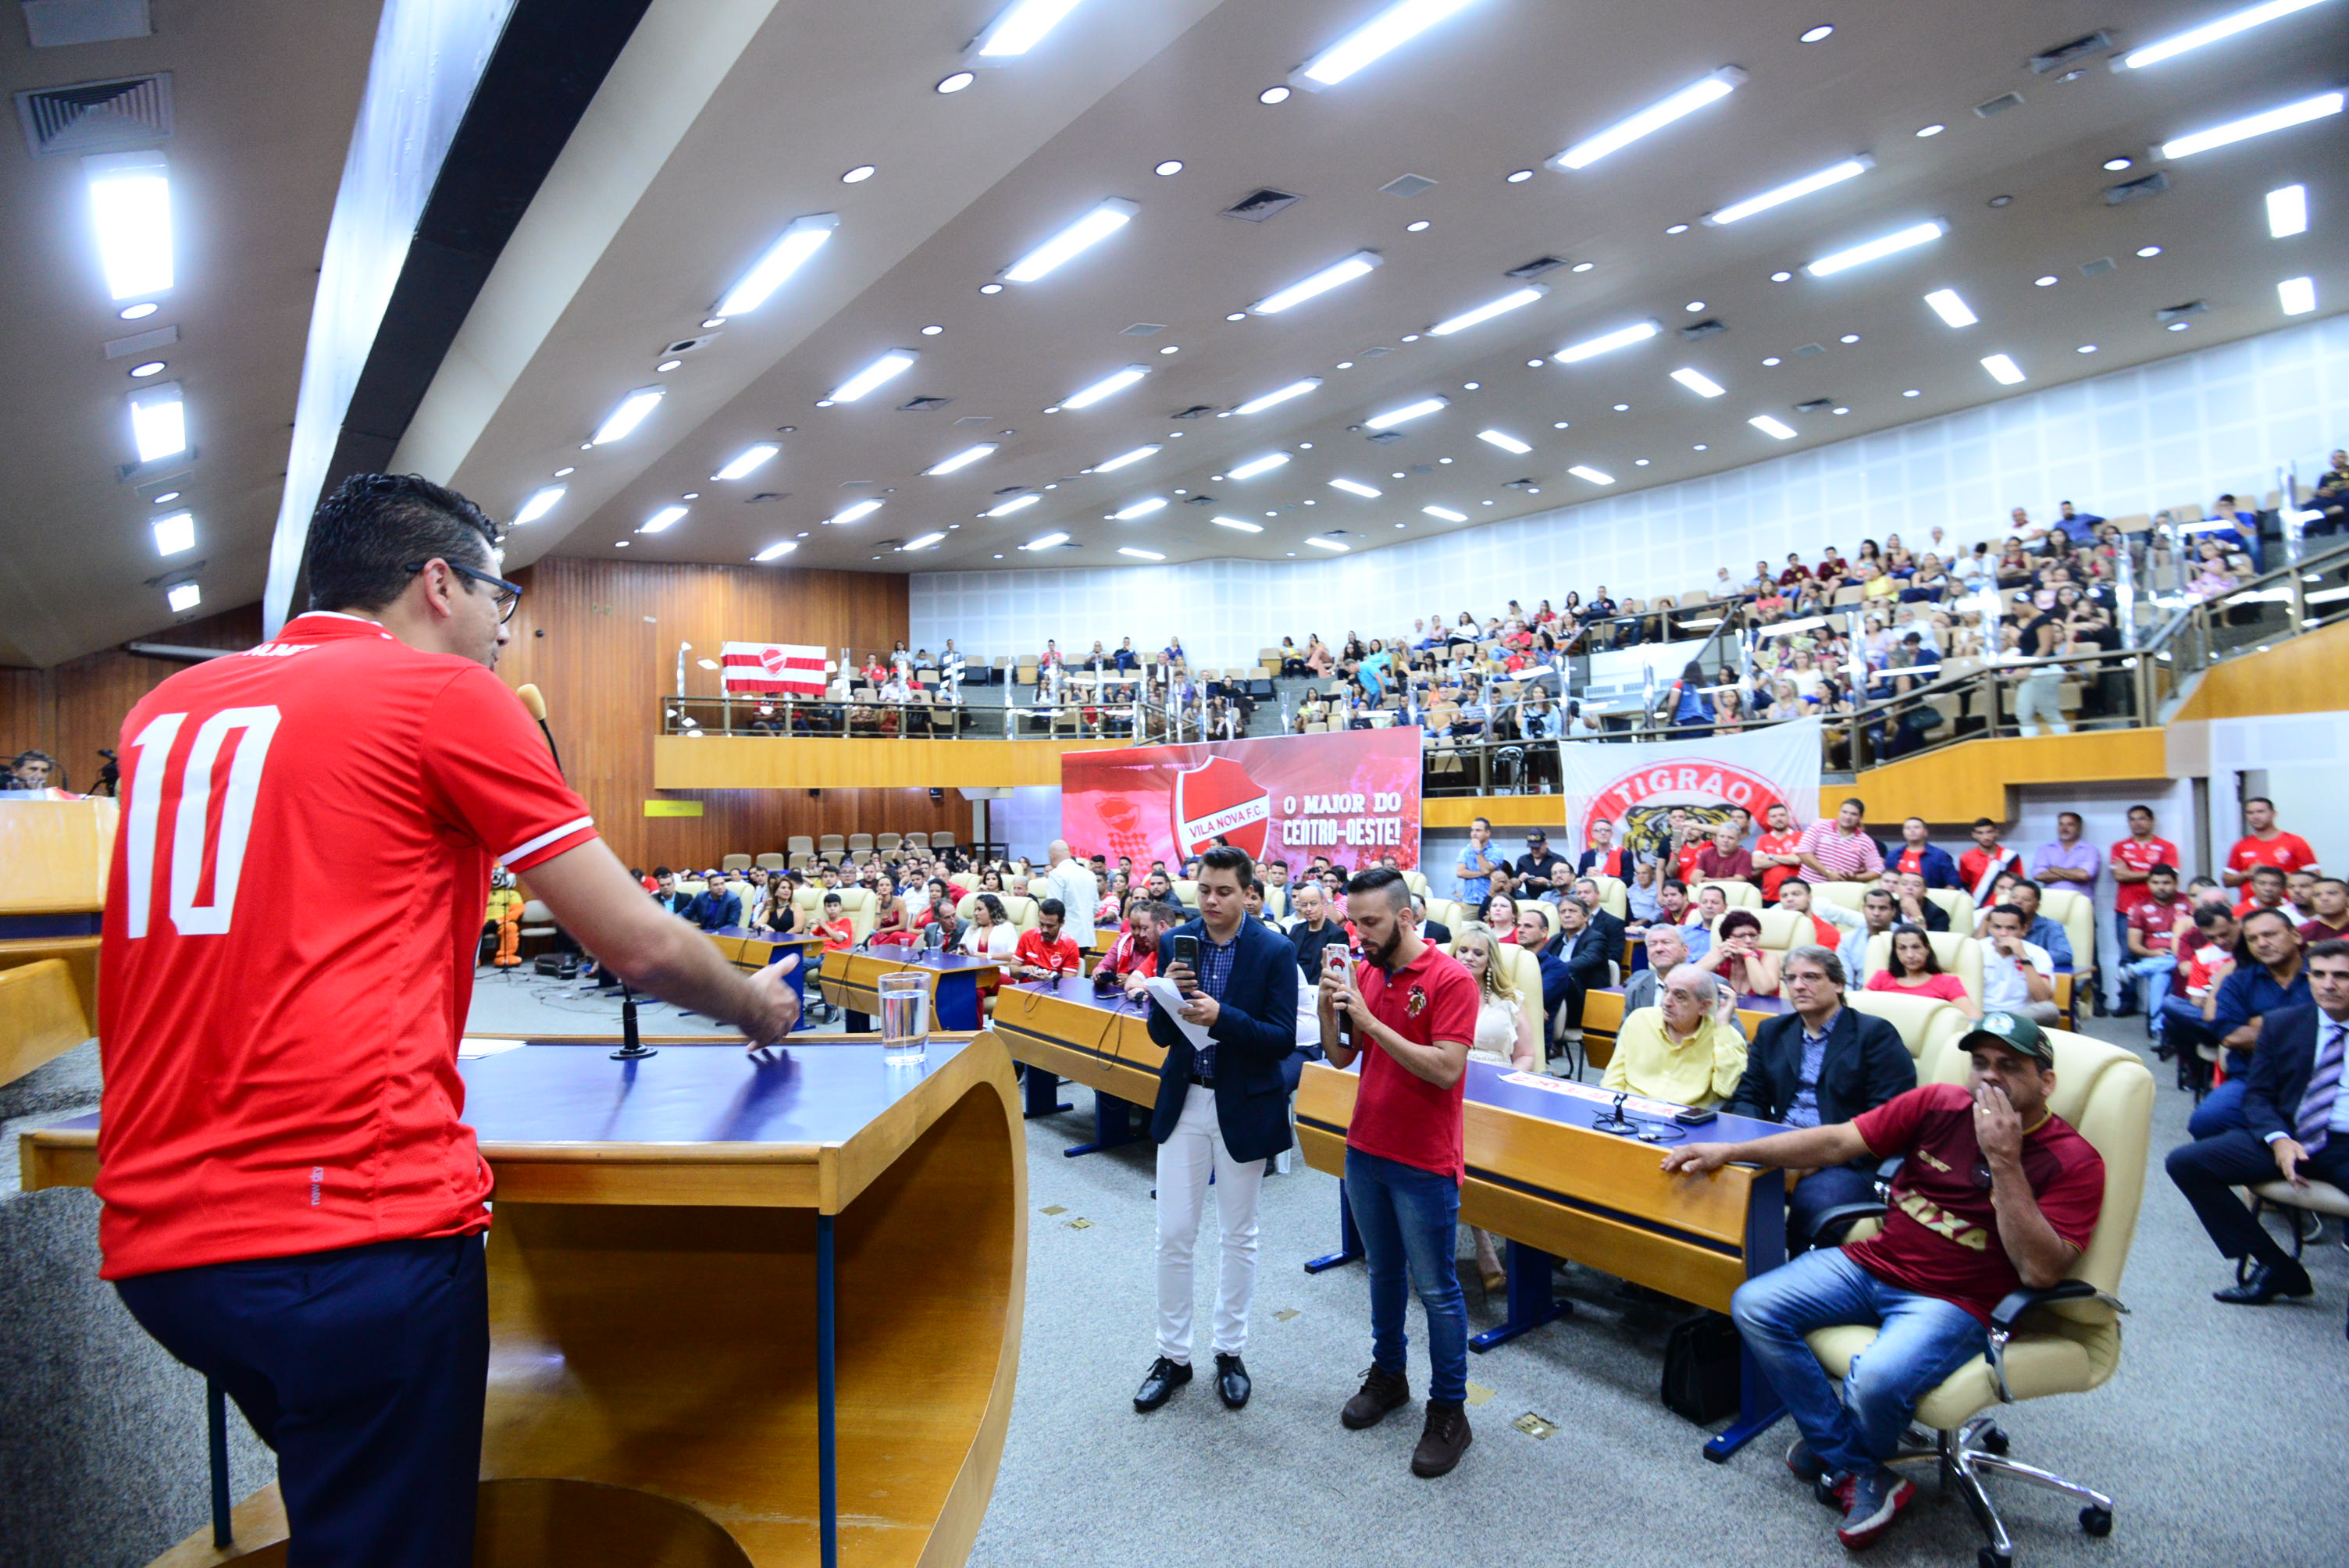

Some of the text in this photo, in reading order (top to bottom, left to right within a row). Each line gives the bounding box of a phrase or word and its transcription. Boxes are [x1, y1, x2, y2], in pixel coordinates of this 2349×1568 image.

[1613, 768, 1752, 807] TIGRÃO
[1283, 791, 1402, 814] O MAIOR DO
[127, 705, 282, 939] 10
[1189, 821, 1216, 838] VILA
[1216, 811, 1246, 829] NOVA
[1283, 818, 1401, 846] CENTRO-OESTE!
